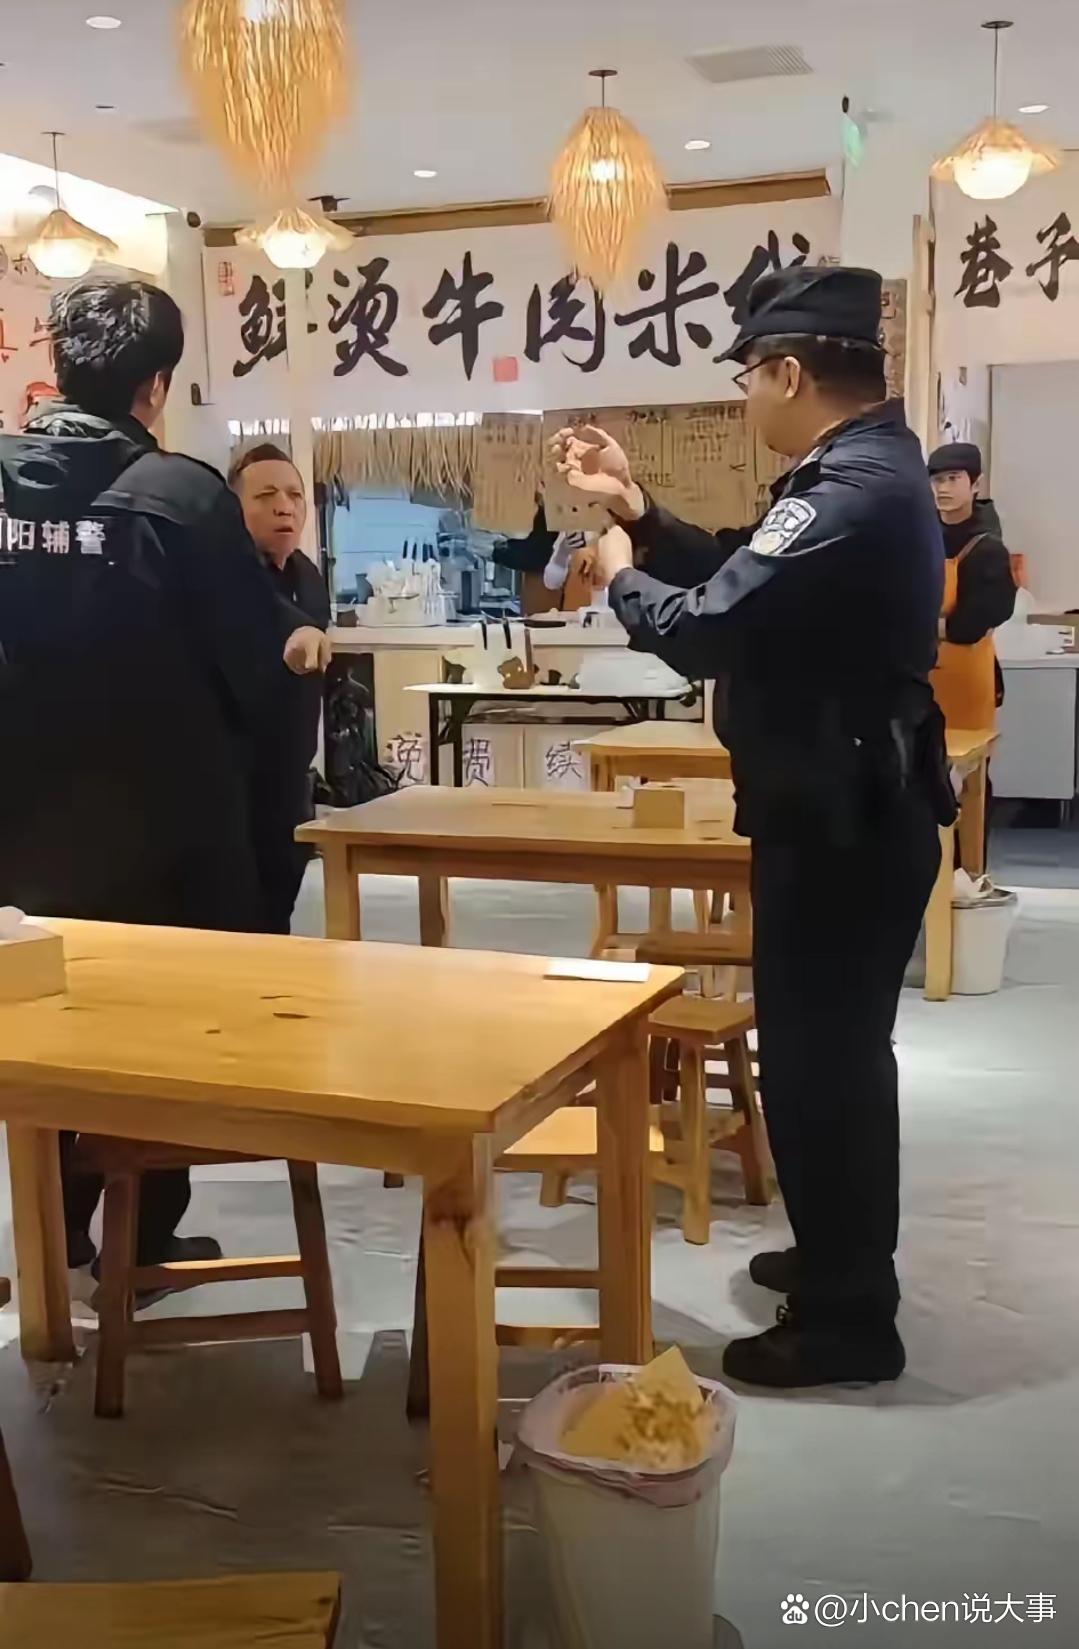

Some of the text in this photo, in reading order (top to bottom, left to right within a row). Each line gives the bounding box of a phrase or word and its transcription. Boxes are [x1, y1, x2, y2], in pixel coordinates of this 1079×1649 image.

[953, 211, 1079, 308] 巷子
[0, 513, 106, 555] 阳辅警
